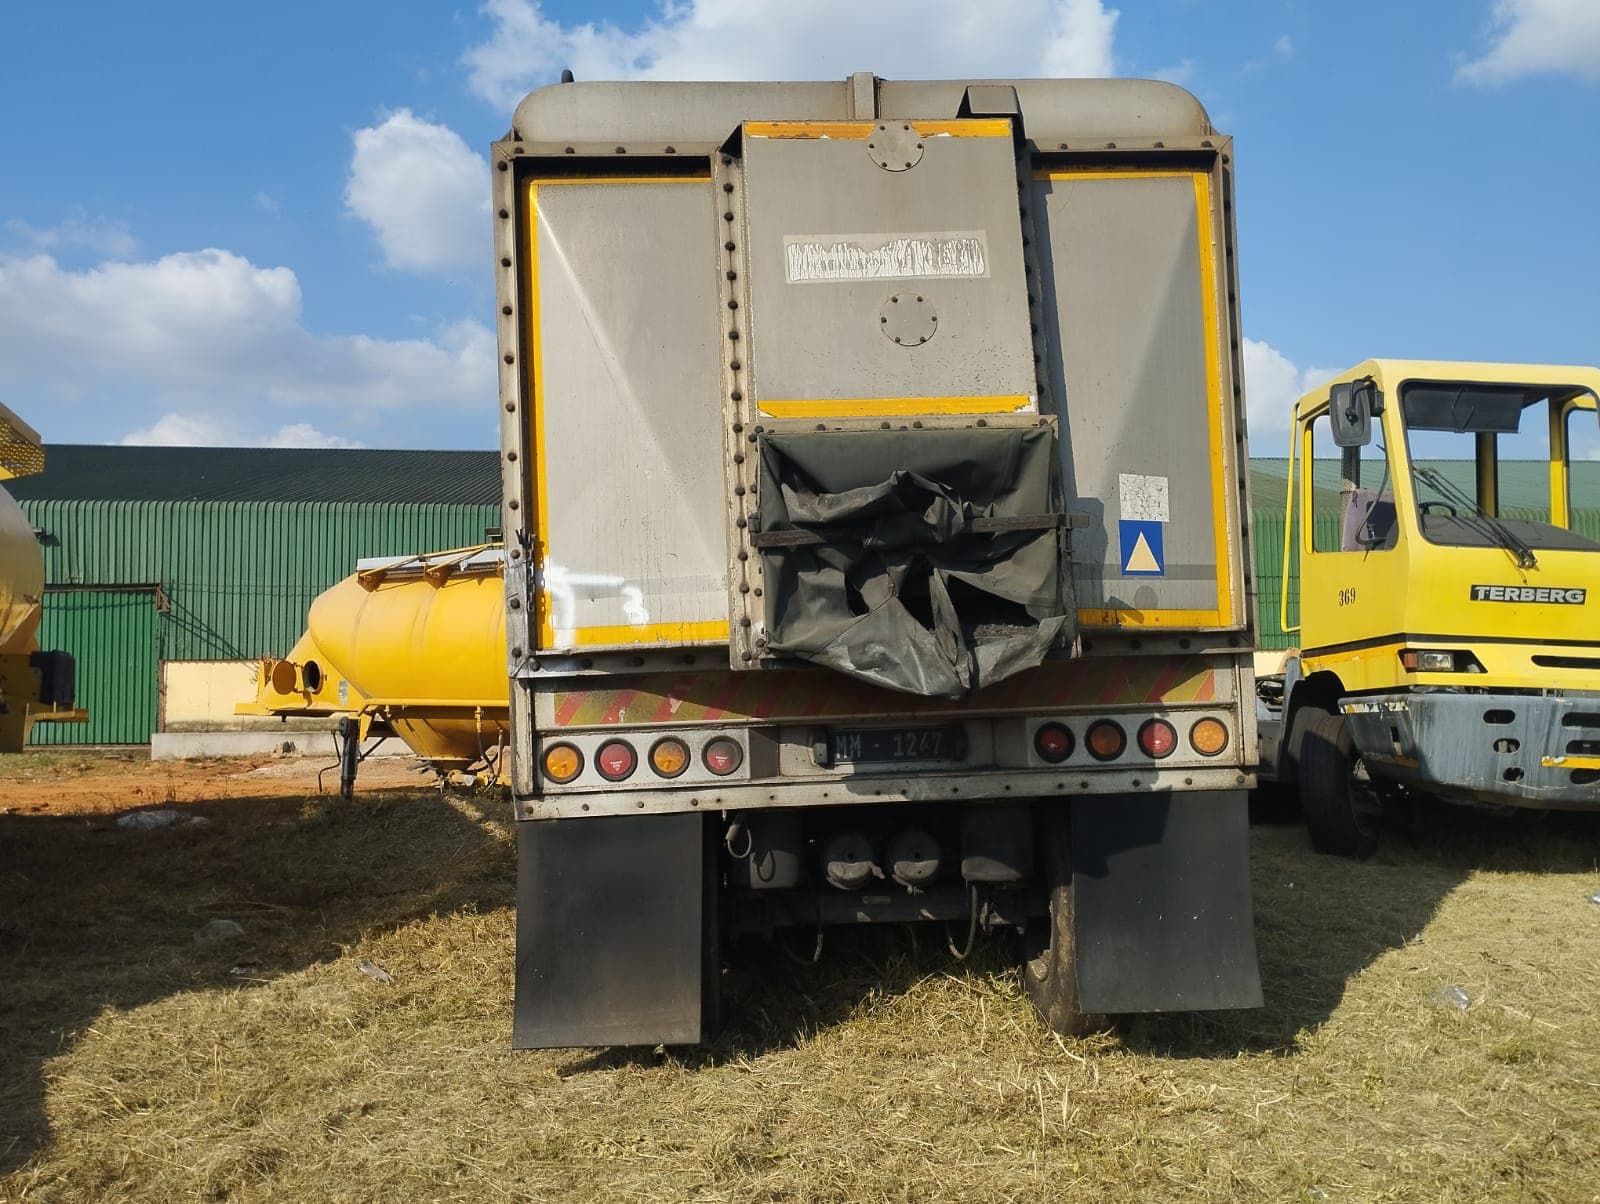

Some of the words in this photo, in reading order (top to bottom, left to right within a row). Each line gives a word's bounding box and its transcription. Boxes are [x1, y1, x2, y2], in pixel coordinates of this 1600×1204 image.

[1338, 586, 1356, 607] 369
[1474, 585, 1584, 603] TERBERG
[836, 735, 861, 759] MM
